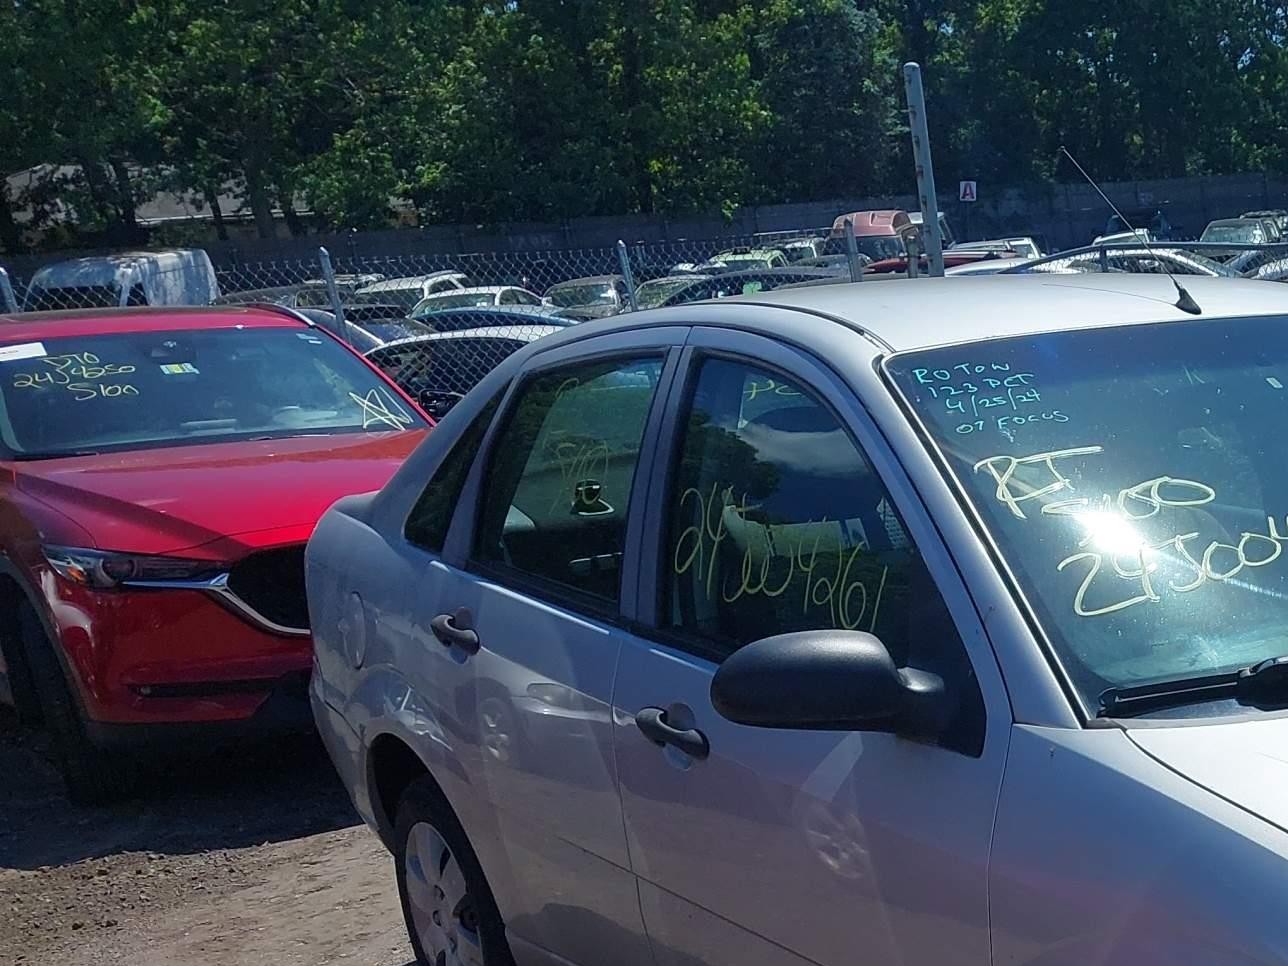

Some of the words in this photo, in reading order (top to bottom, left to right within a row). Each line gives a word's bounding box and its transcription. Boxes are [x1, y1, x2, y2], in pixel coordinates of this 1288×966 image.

[961, 182, 976, 200] A
[912, 368, 951, 384] RO
[954, 362, 1010, 375] TOW
[928, 382, 978, 398] 123
[946, 388, 1041, 416] 4/25/24
[997, 410, 1070, 430] FOCUS
